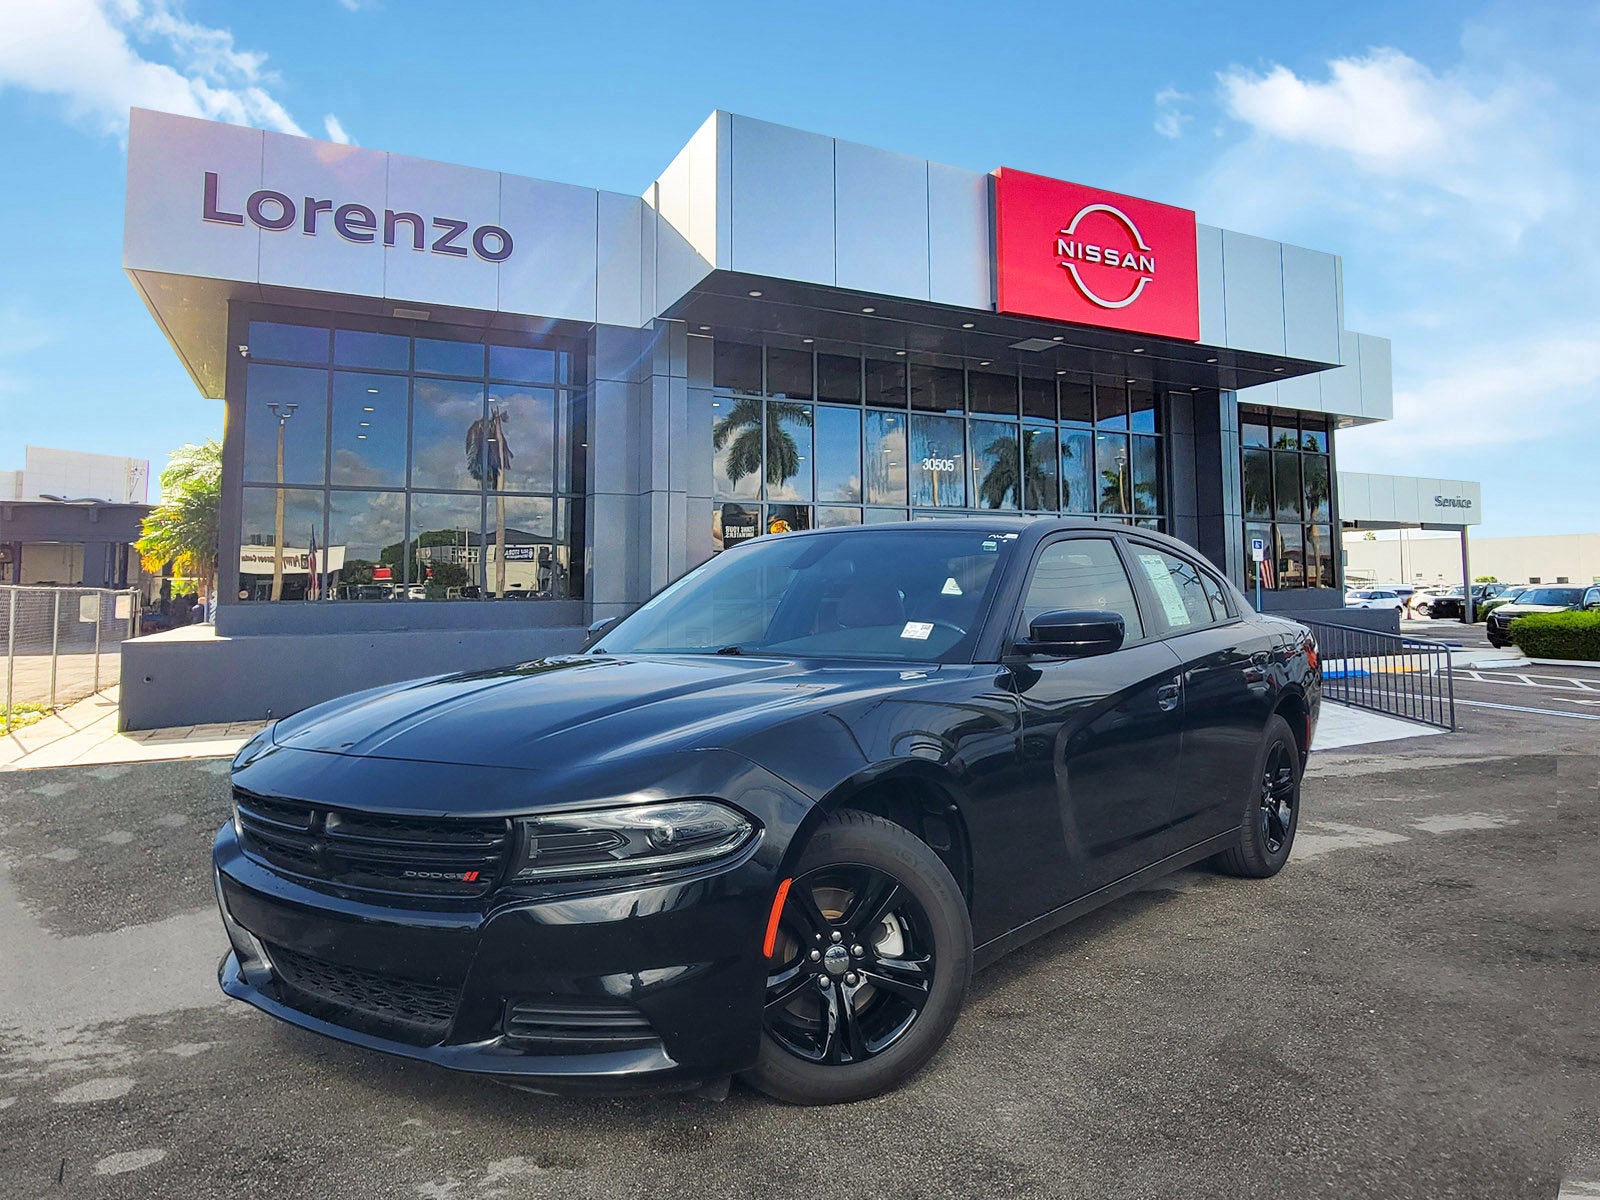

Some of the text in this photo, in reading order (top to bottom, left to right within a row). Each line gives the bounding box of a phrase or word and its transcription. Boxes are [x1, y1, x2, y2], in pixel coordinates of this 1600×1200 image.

[203, 171, 514, 262] Lorenzo
[1057, 238, 1155, 273] NISSAN
[922, 458, 955, 471] 30505
[1434, 495, 1472, 508] Service
[404, 870, 464, 879] DODGE
